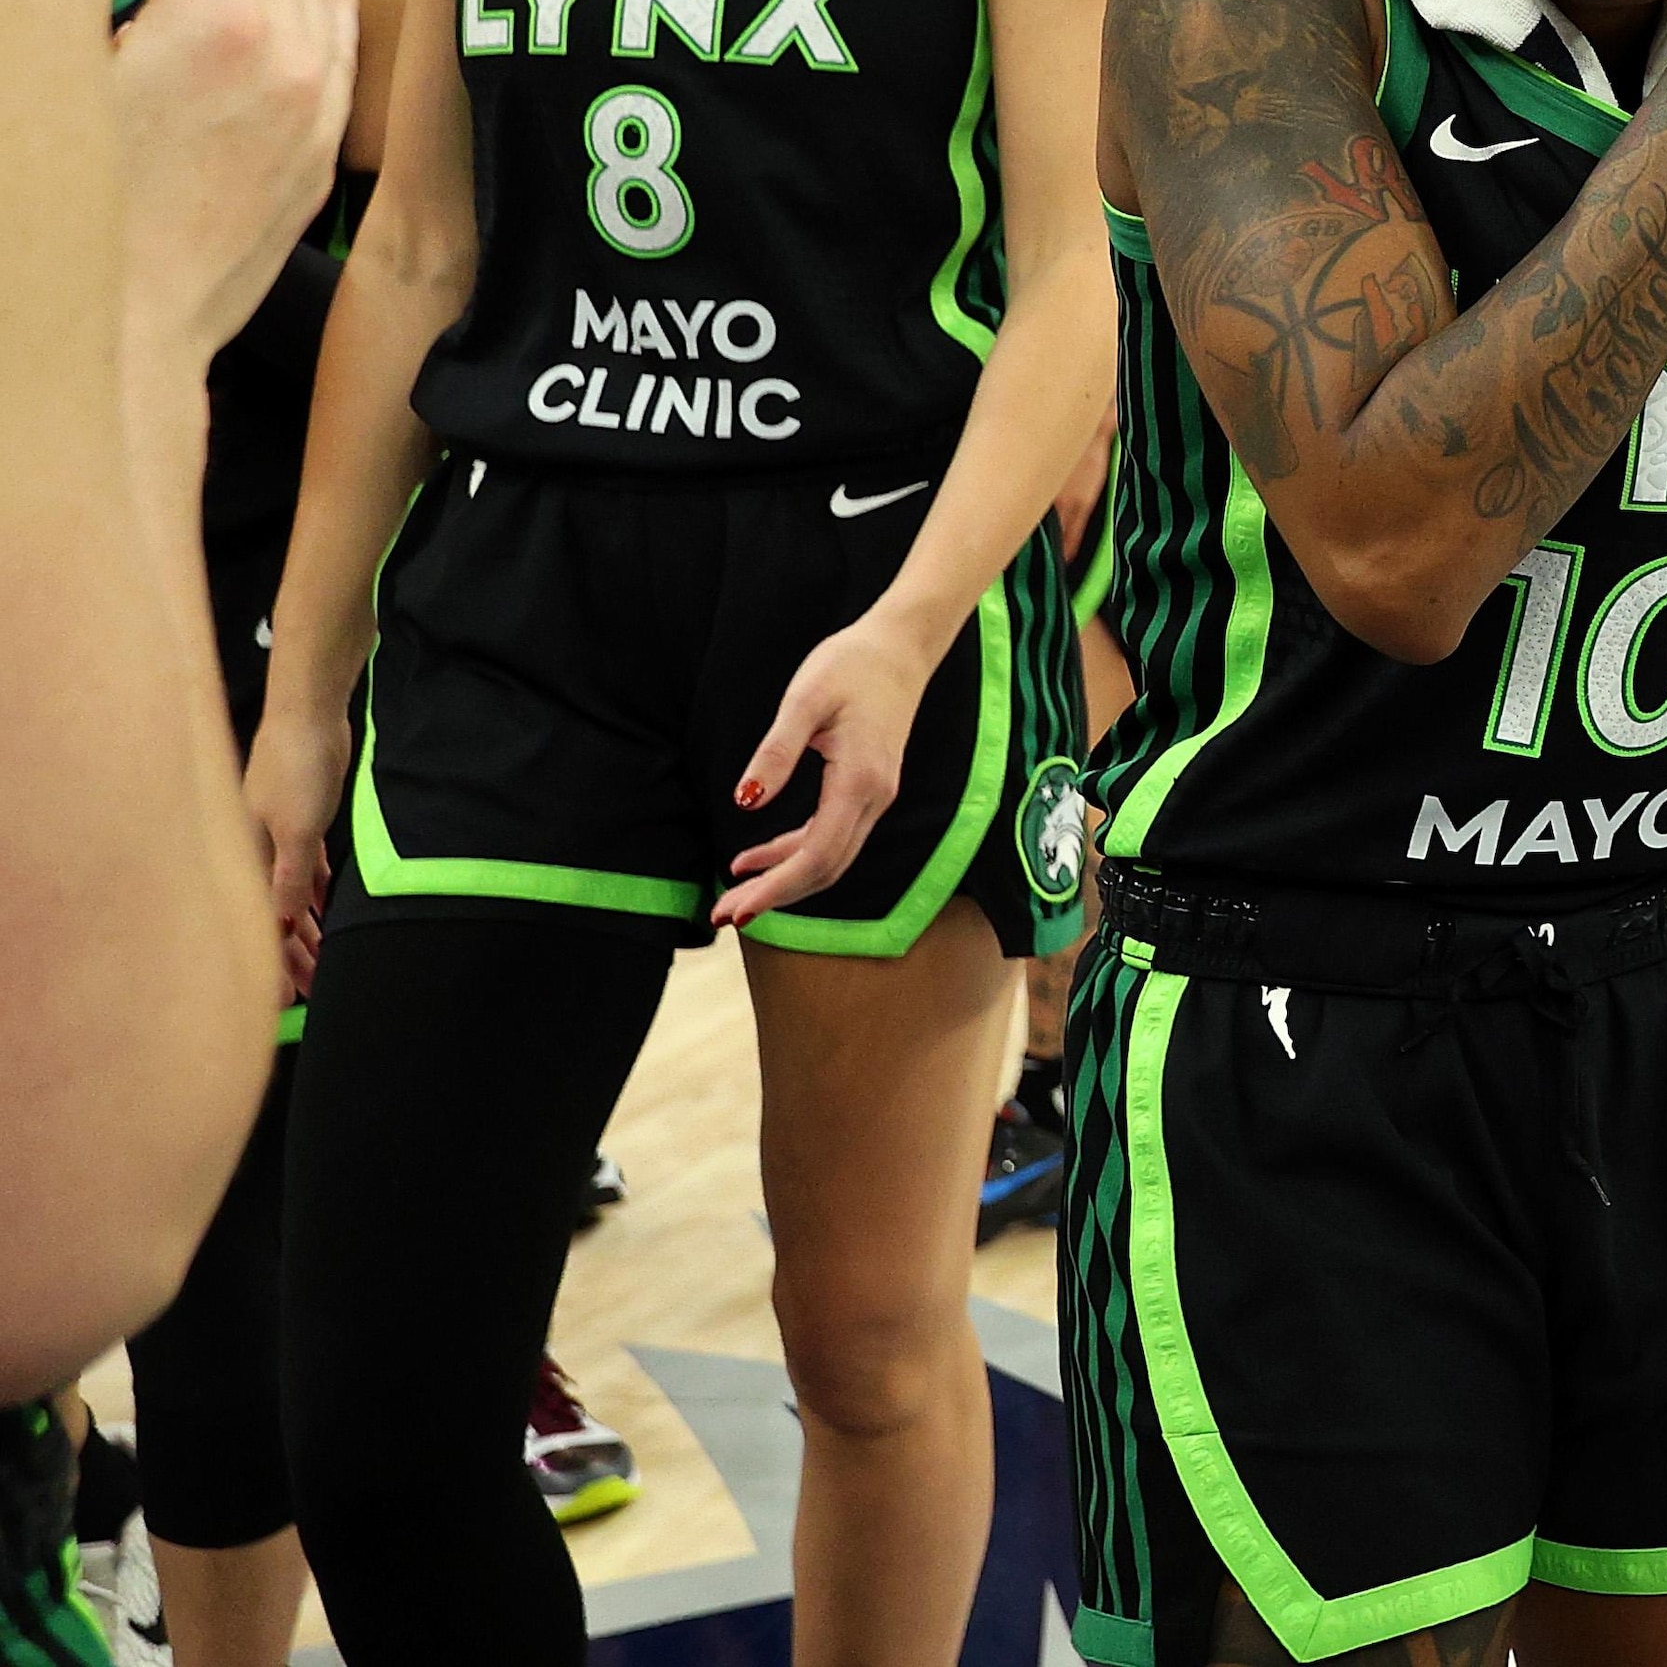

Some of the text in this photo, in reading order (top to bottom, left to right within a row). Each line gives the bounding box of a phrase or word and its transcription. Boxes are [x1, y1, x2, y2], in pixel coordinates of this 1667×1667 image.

[584, 84, 695, 260] 8
[572, 288, 777, 364] MAYO
[527, 362, 802, 442] CLINIC
